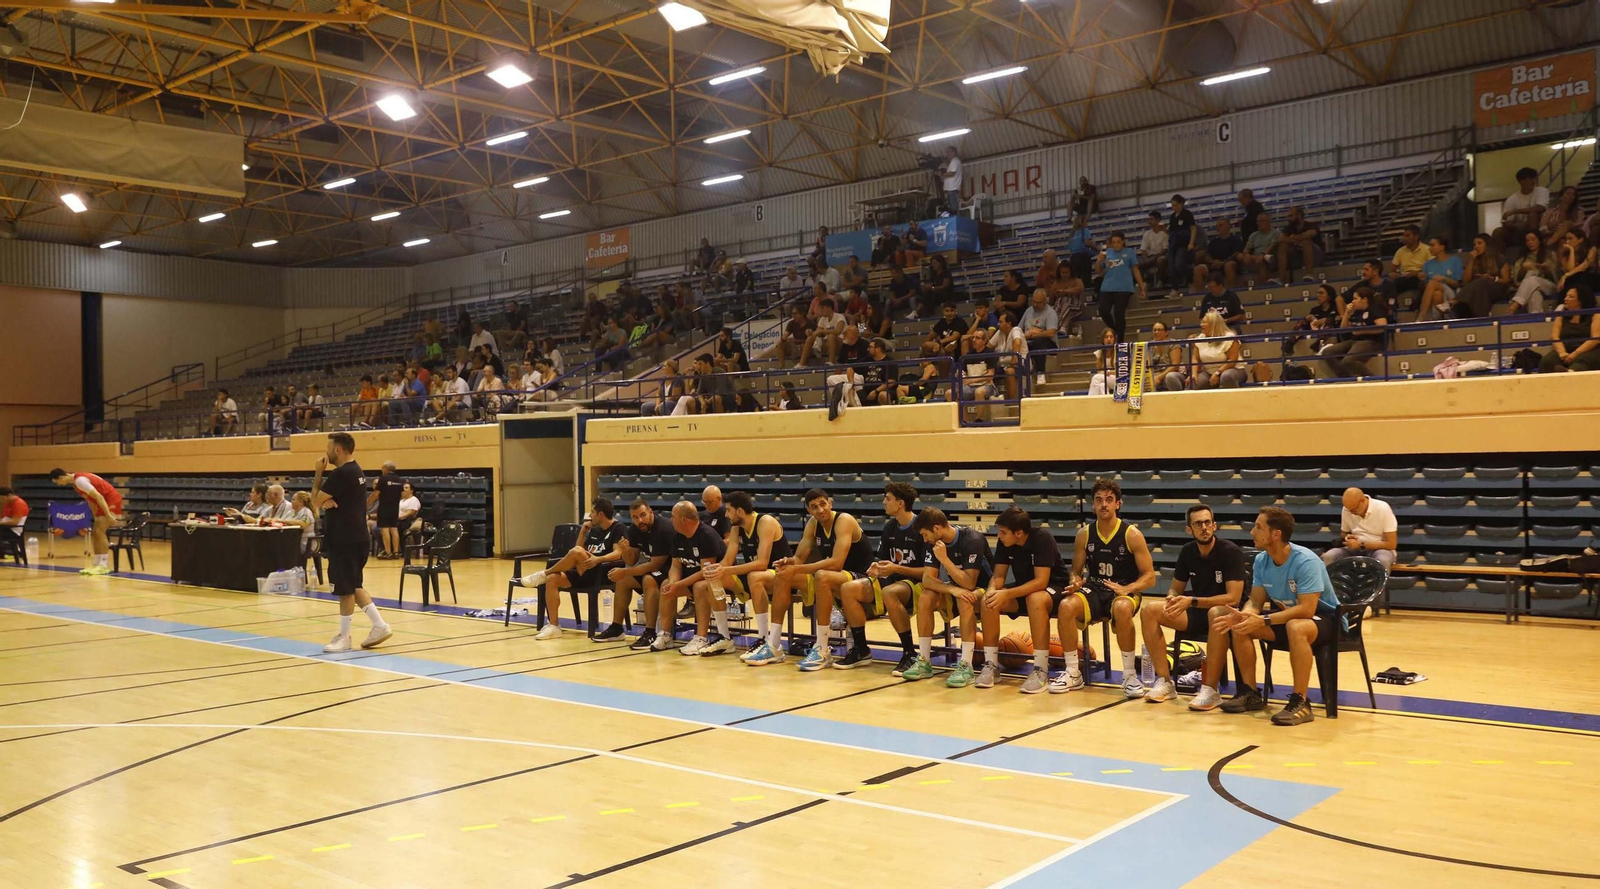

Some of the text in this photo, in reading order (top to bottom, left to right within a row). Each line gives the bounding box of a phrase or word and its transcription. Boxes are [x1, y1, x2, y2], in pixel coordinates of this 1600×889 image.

[1511, 64, 1554, 84] Bar
[1480, 76, 1590, 111] Cafetería
[1219, 122, 1230, 142] C
[961, 164, 1042, 202] UMAR
[756, 205, 764, 221] B
[600, 232, 616, 244] Bar
[502, 251, 509, 265] A
[744, 329, 780, 341] Delegación
[1118, 355, 1129, 377] UDEA
[626, 424, 658, 433] PRENSA
[688, 423, 698, 432] TV
[414, 435, 437, 443] PRENSA
[457, 432, 466, 441] TV
[56, 512, 86, 521] molten
[1098, 562, 1113, 578] 30
